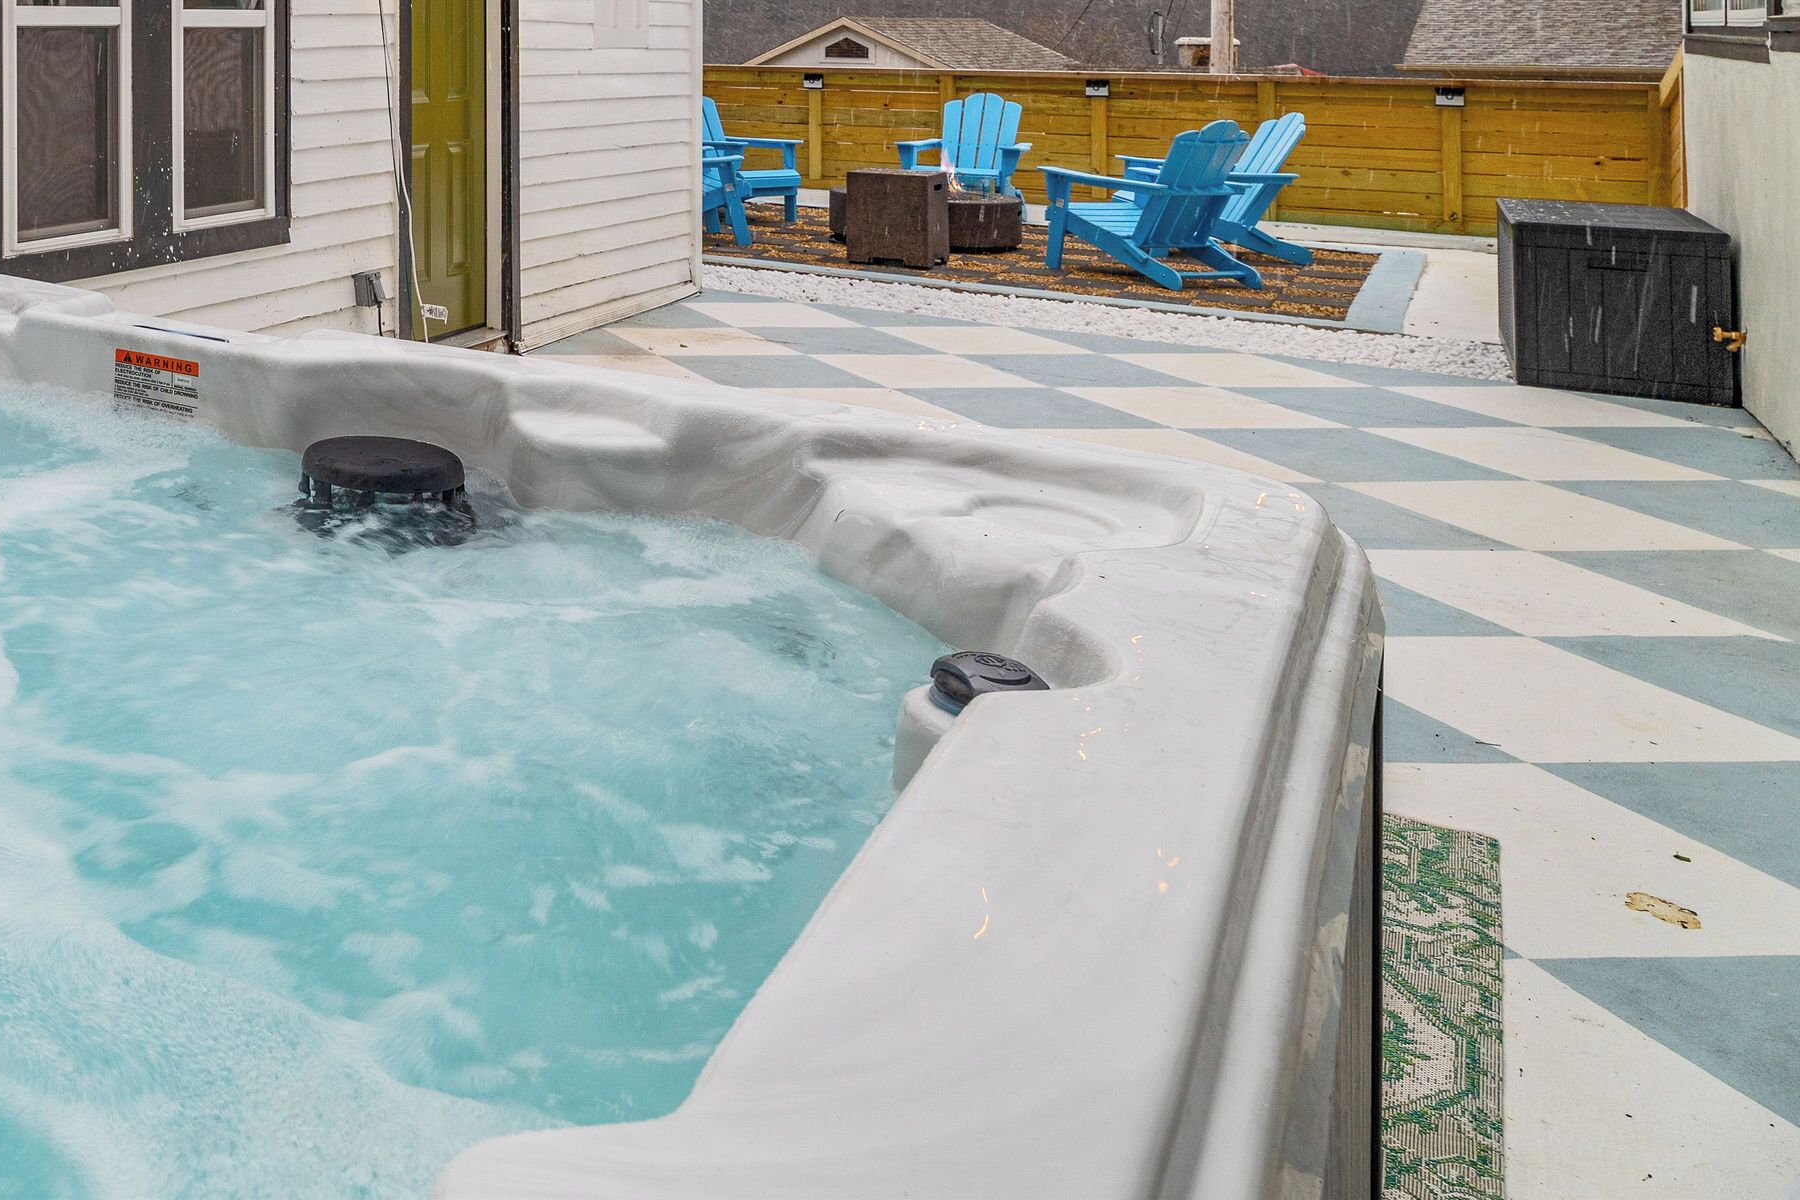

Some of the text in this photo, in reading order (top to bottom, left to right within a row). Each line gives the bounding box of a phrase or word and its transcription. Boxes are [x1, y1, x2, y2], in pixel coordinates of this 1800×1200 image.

[115, 362, 132, 370] REDUCE
[135, 355, 192, 373] WARNING
[114, 368, 152, 378] ELECTROCUTION
[114, 379, 131, 387] REDUCE
[174, 389, 198, 399] DROWNING
[142, 398, 153, 406] RISK
[161, 402, 193, 413] OVERHEATING
